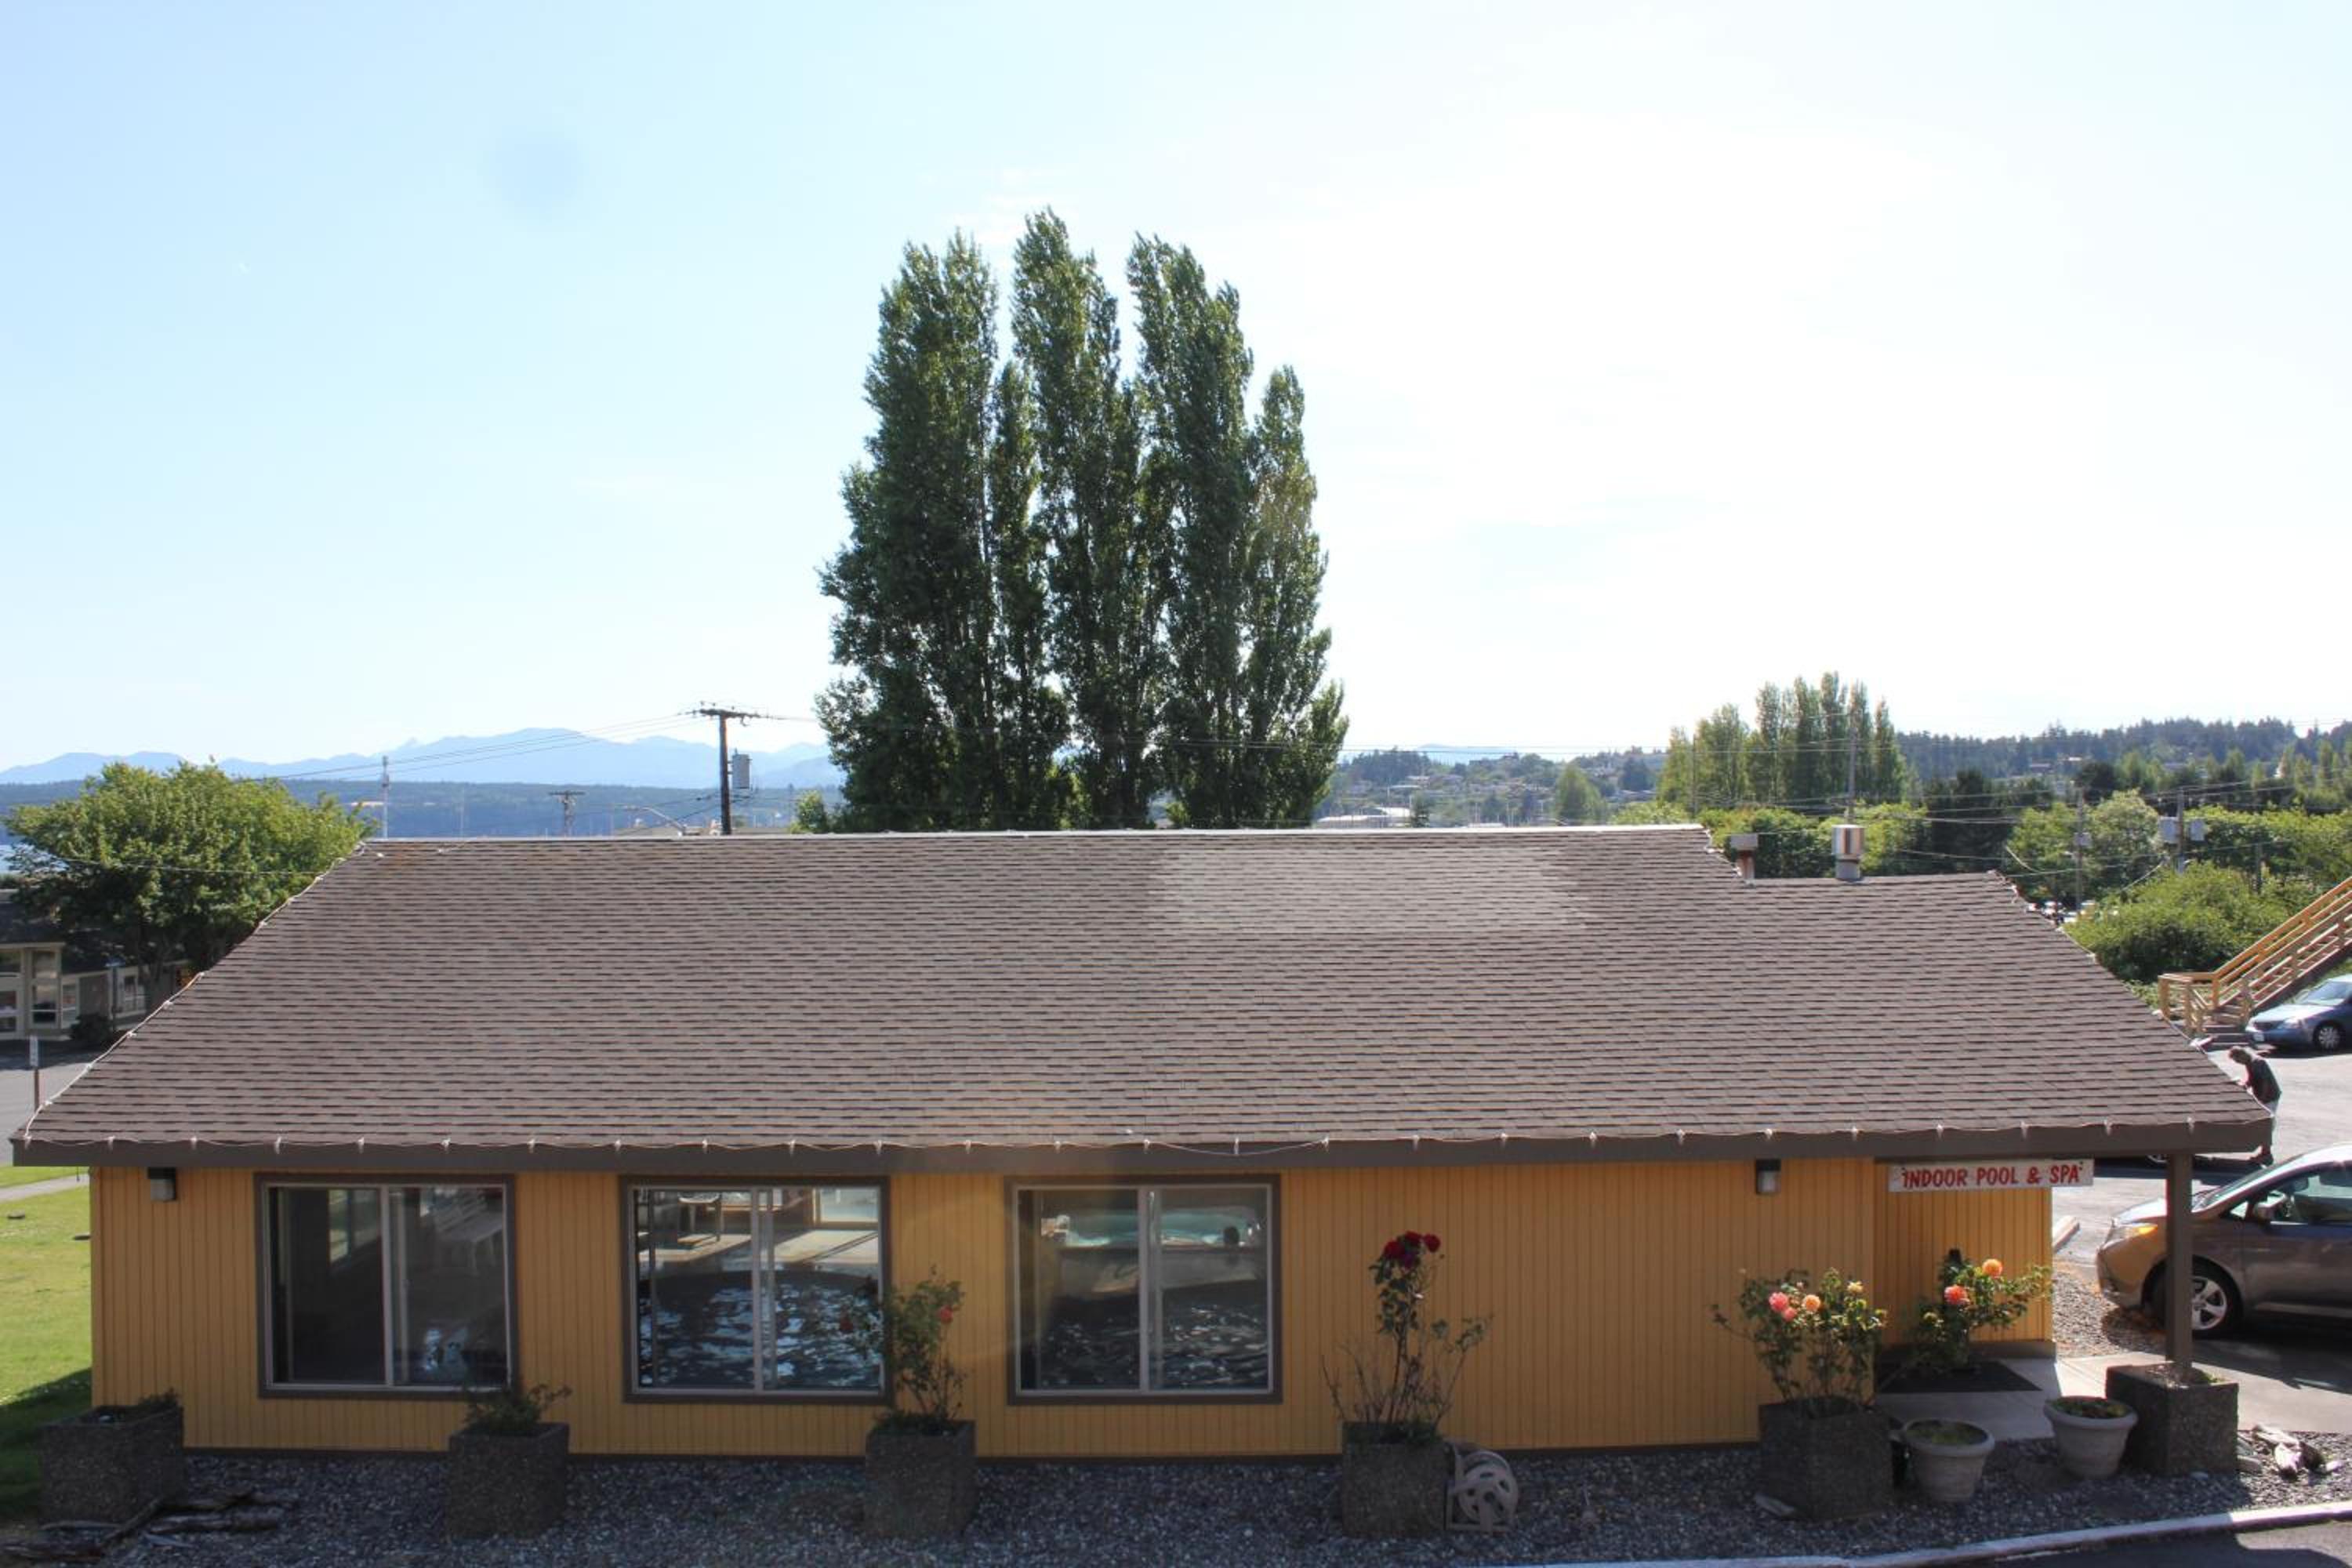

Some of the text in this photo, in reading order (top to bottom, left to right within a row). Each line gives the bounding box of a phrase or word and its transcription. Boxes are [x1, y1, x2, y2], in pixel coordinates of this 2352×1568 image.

[1903, 1164, 2080, 1188] INDOOR POOL & SPA
